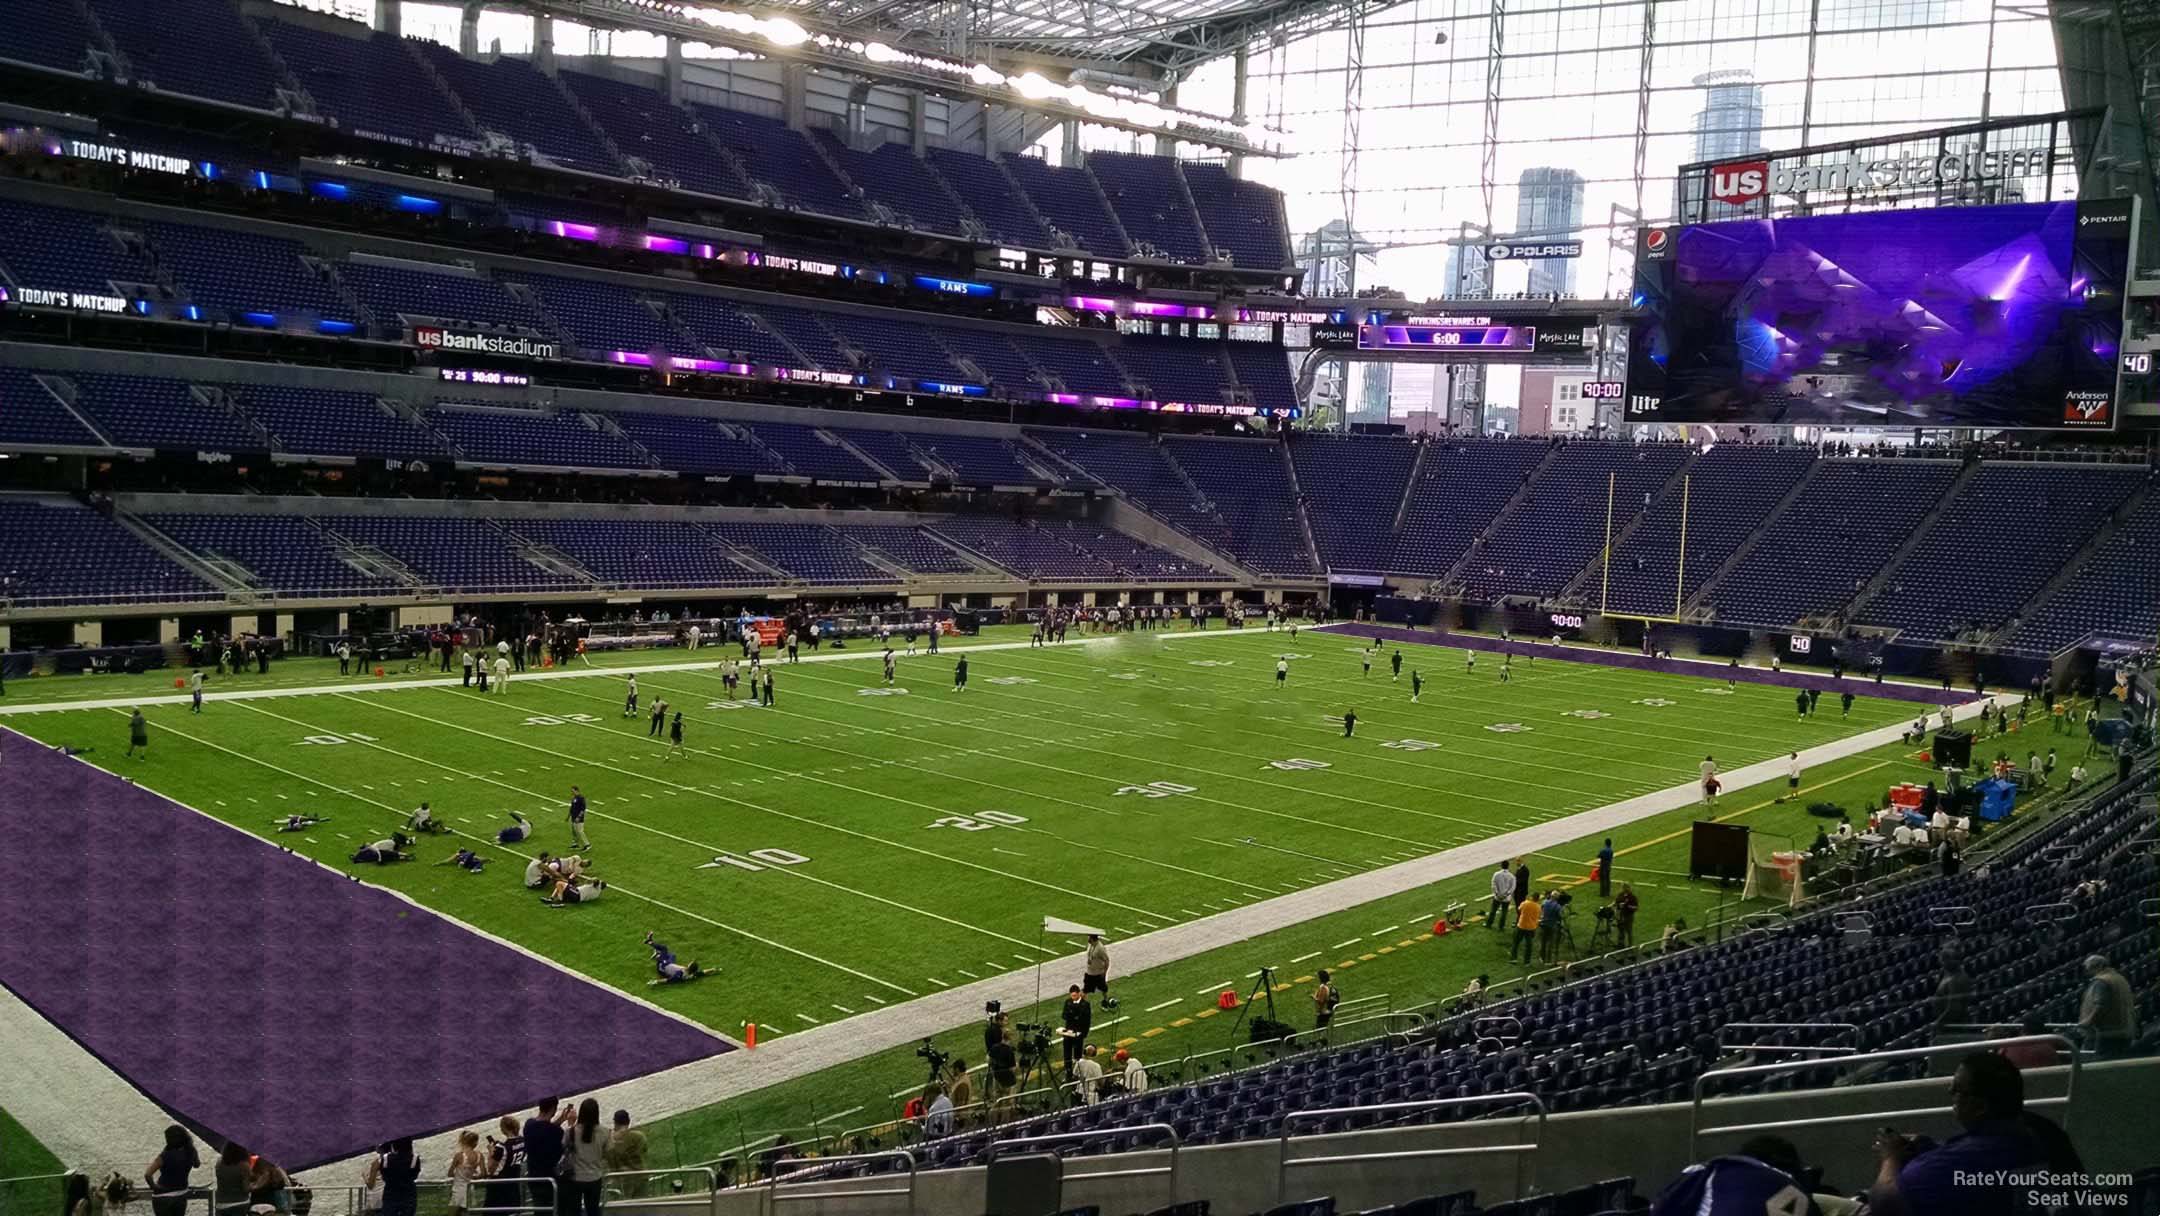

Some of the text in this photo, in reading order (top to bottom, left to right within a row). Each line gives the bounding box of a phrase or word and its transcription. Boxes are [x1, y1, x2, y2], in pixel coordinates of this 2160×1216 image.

[72, 141, 190, 175] TODAY'S MATCHUP
[2090, 215, 2127, 223] PENTAIR
[1513, 244, 1580, 257] POLARIS
[765, 255, 837, 276] TODAY'S MATCHUP
[940, 281, 968, 294] RAMS
[18, 288, 127, 313] TODAY'S MATCHUP
[1256, 311, 1327, 324] TODAY'S MATCHUP
[1432, 332, 1460, 345] 6:00
[2125, 356, 2149, 372] 40
[472, 372, 501, 384] 90:00
[939, 384, 964, 394] RAMS
[1583, 383, 1622, 397] 90:00
[2065, 391, 2108, 400] Andersen
[1197, 403, 1224, 415] TODAY'S
[1631, 395, 1660, 414] Lite
[1551, 614, 1582, 628] 90:00
[1792, 638, 1809, 650] 40
[935, 810, 1030, 832] 20
[713, 848, 812, 872] 10
